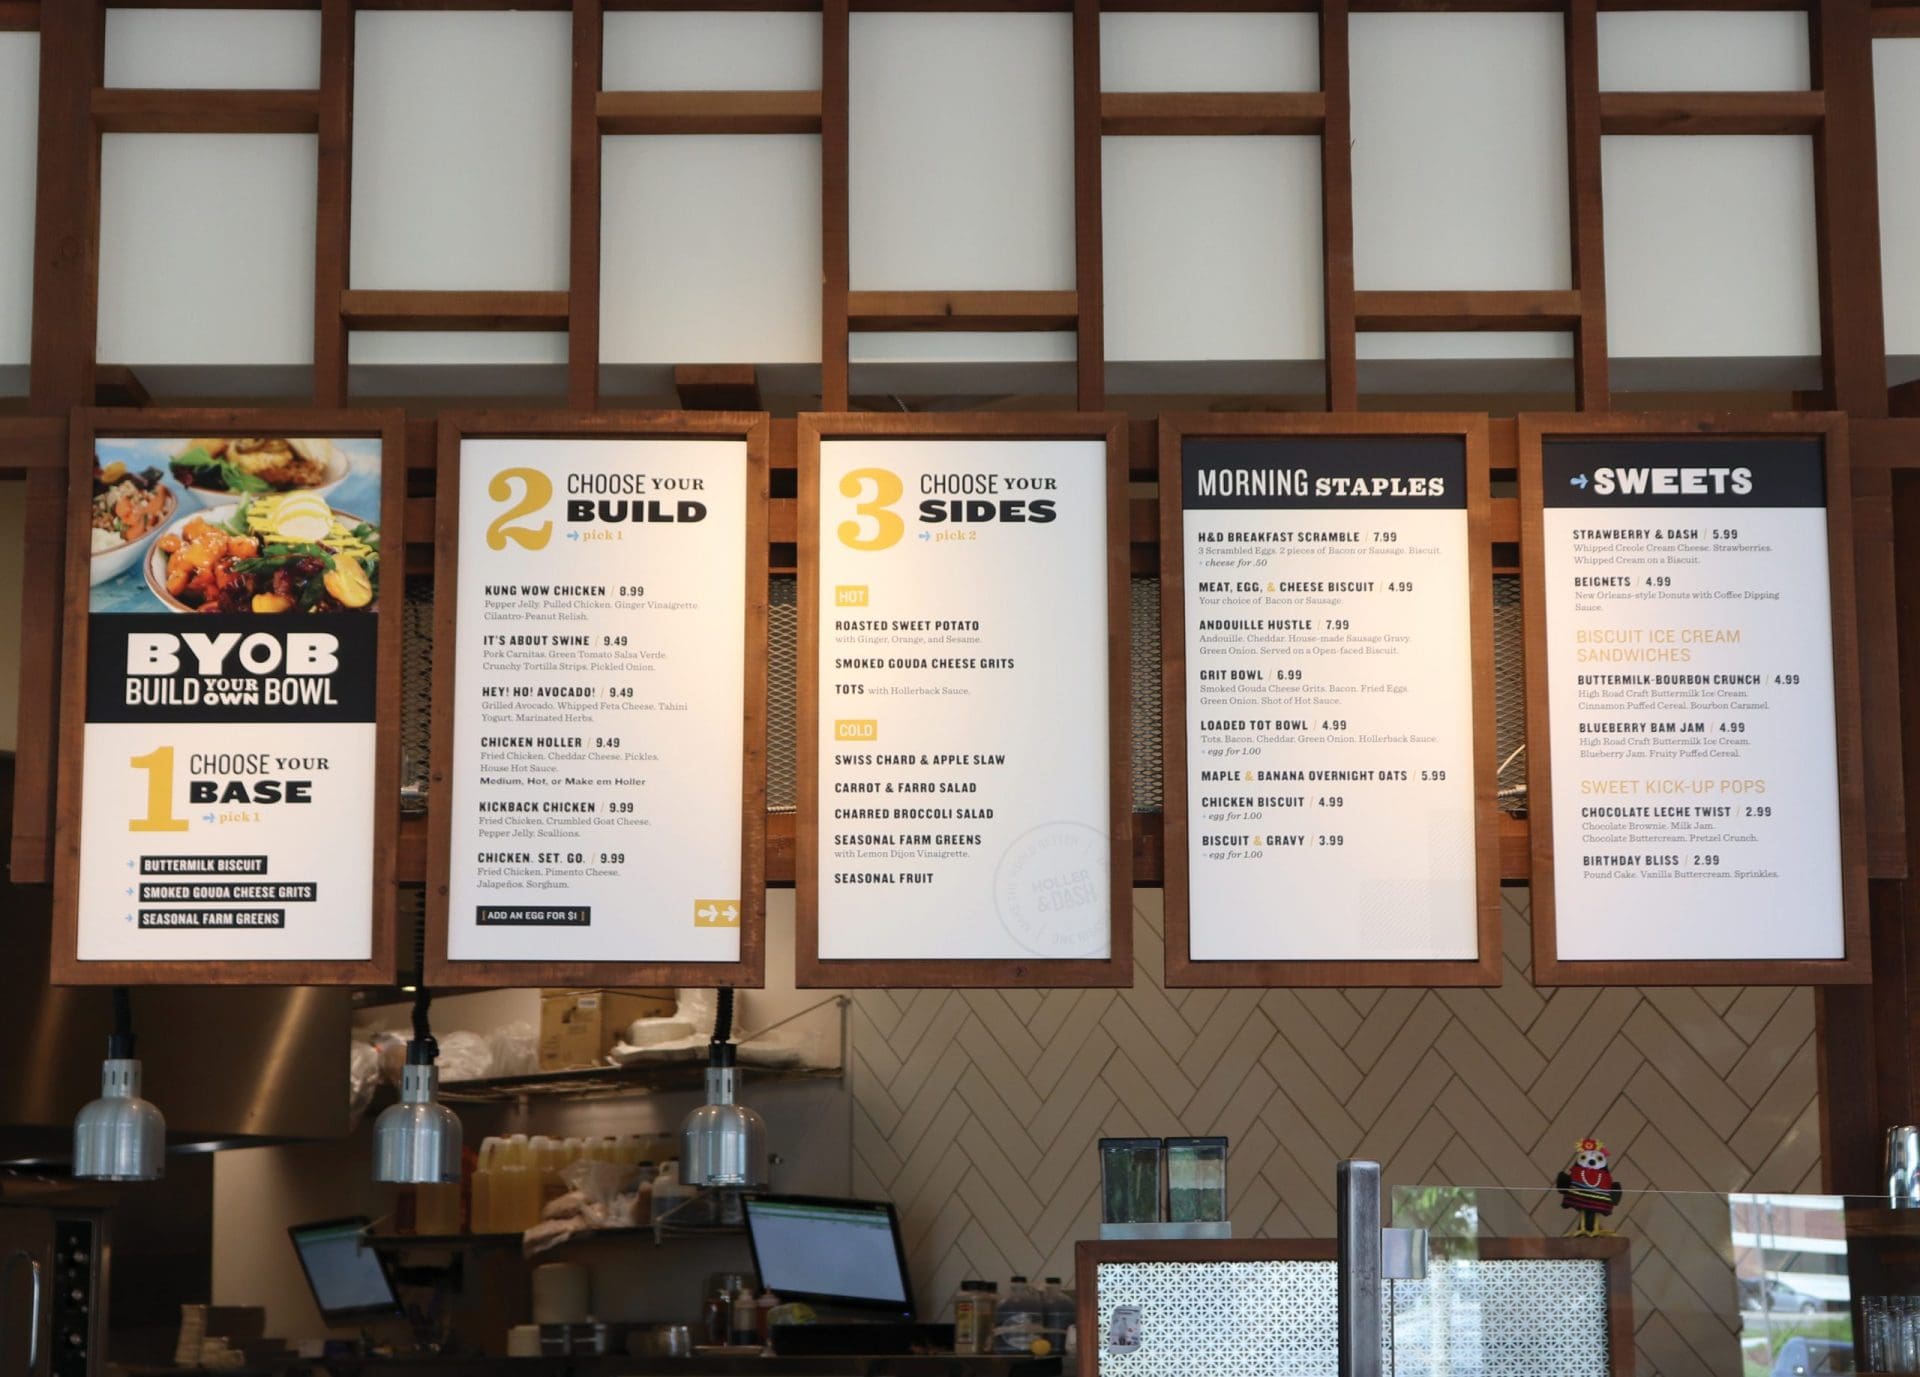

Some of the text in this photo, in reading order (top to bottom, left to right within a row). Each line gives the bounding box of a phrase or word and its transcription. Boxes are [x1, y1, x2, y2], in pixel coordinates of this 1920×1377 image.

[568, 474, 704, 494] CHOOSE YOUR
[921, 474, 1057, 494] CHOOSE YOUR
[1198, 469, 1444, 496] MORNING STAPLES
[1594, 468, 1752, 495] SWEETS
[486, 467, 553, 551] 2
[567, 500, 707, 523] BUILD
[837, 468, 905, 552] 3
[919, 500, 1056, 523] SIDES
[583, 530, 622, 542] pick 1
[936, 530, 977, 542] pick 2
[1198, 532, 1396, 542] H&D BREAKFAST SCRAMBLE 7.99
[1575, 576, 1671, 587] BEIGNETS 4.99
[485, 586, 644, 596] KUNG WOW CHICKEN 8.99
[840, 590, 864, 602] HOT
[1597, 591, 1656, 600] Orleans-style
[1744, 591, 1780, 600] Dipping
[836, 621, 979, 631] ROASTED SWEET POTATO
[1199, 620, 1349, 630] ANDOUILLE HUSTLE 7.99
[1577, 630, 1740, 644] BISCUIT ICE CREAM
[127, 633, 338, 675] BYOB
[1577, 648, 1690, 662] SANDWICHES
[483, 662, 522, 671] Crunchy
[1200, 670, 1302, 680] GRIT BOWL 6.99
[1578, 674, 1800, 685] BUTTERMILK-BOURBON CRUNCH 4.99
[126, 678, 338, 705] BUILD YOUR OWN BOWL
[482, 687, 633, 698] HEY! HO! AVOCADO! 9.49
[835, 684, 864, 694] TOTS
[891, 686, 940, 694] Hollerback
[1578, 690, 1600, 699] High
[1626, 689, 1649, 697] Craft
[1651, 689, 1700, 697] Buttermilk
[840, 724, 873, 736] COLD
[1201, 720, 1346, 731] LOADED TOT BOWL 4.99
[481, 737, 620, 748] CHICKEN HOLLER 9.49
[1225, 747, 1240, 756] for
[190, 754, 329, 775] CHOOSE YOUR
[835, 755, 1005, 765] SWISS CHARD & APPLE SLAW
[128, 746, 190, 832] 1
[190, 780, 312, 804] BASE
[1581, 780, 1765, 794] SWEET KICK-UP POPS
[1202, 797, 1343, 807] CHICKEN BISCUIT 4.99
[220, 812, 259, 824] pick 1
[835, 808, 993, 819] CHARRED BROCCOLI SALAD
[1582, 806, 1771, 818] CHOCOLATE LECHE TWIST 2.99
[835, 834, 981, 845] SEASONAL FARM GREENS
[890, 850, 915, 859] Dijon
[1583, 855, 1719, 866] BIRTHDAY BLISS 2.99
[144, 859, 262, 871] BUTTERMILK BISCUIT
[834, 873, 934, 884] SEASONAL FRUIT
[144, 886, 311, 898] SMOKED GOUDA CHEESE GRITS
[143, 913, 279, 925] SEASONAL FARM GREENS
